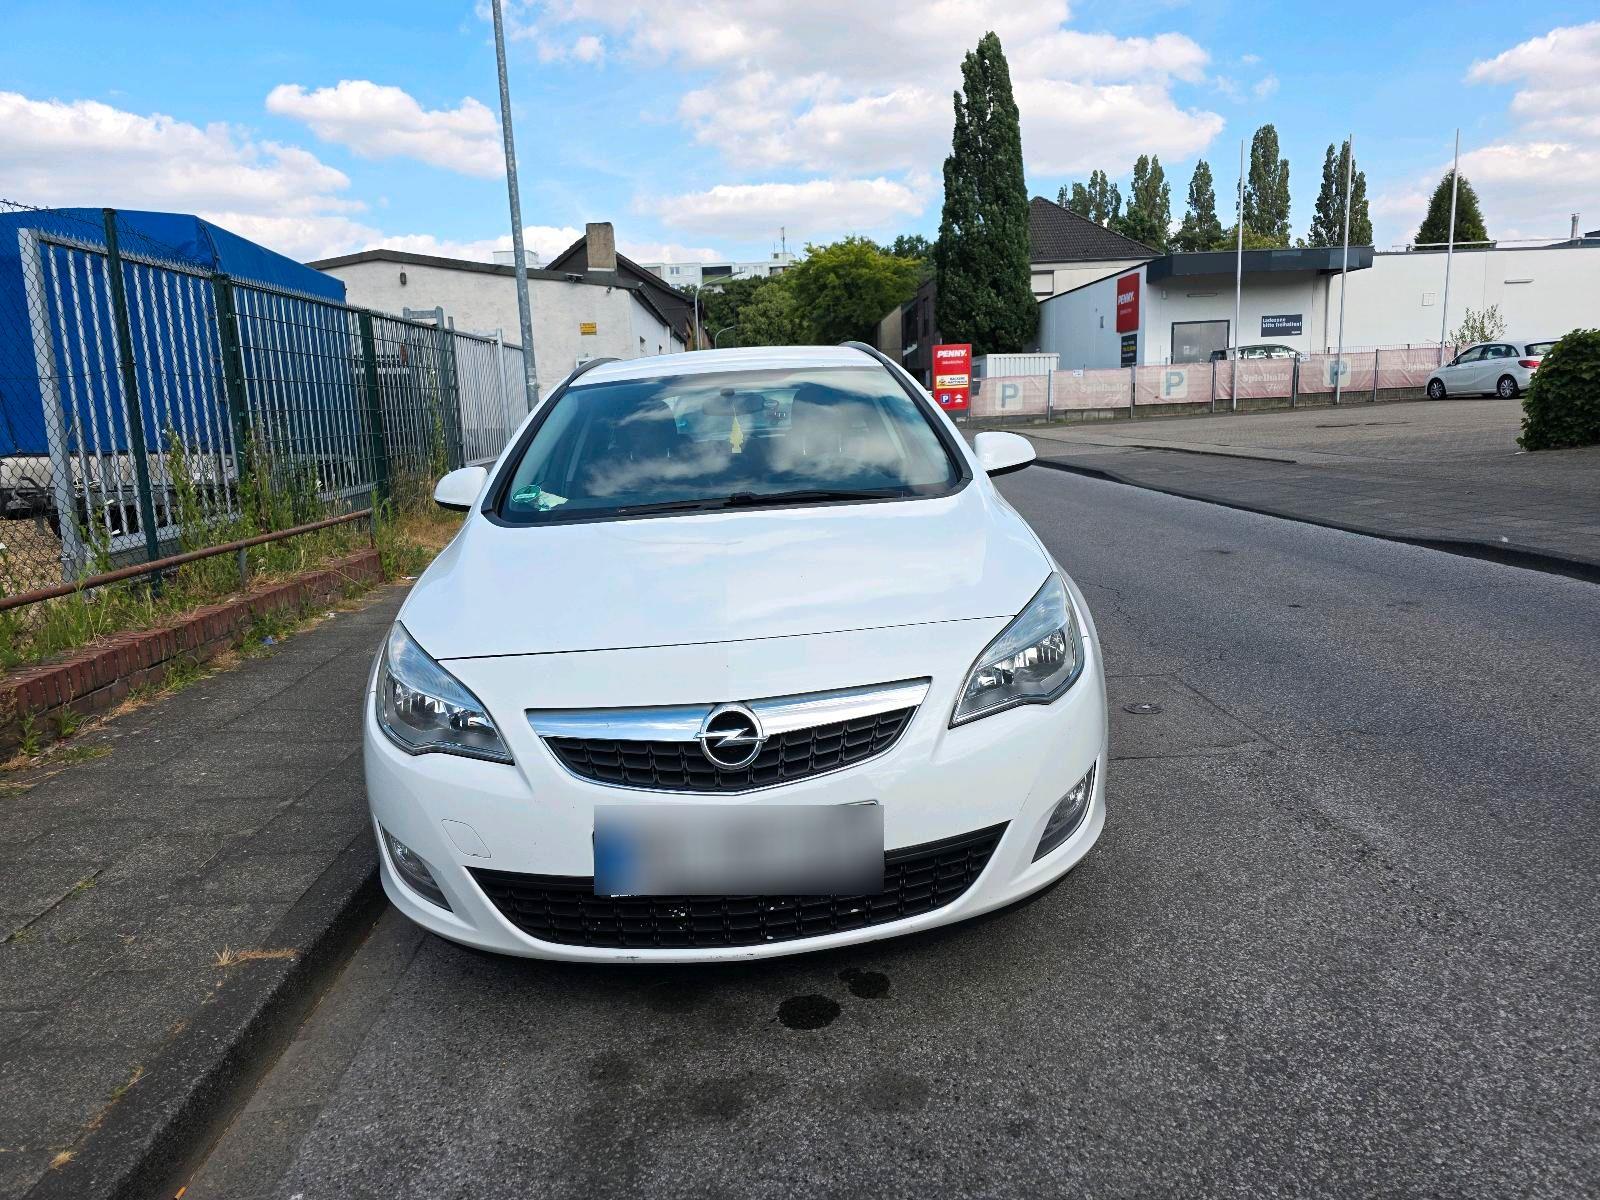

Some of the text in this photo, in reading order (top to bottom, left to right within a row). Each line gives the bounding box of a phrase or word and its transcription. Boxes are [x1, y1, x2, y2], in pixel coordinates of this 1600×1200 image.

[1165, 371, 1184, 396] P
[1242, 372, 1290, 384] Spielhalle
[1000, 383, 1020, 408] P
